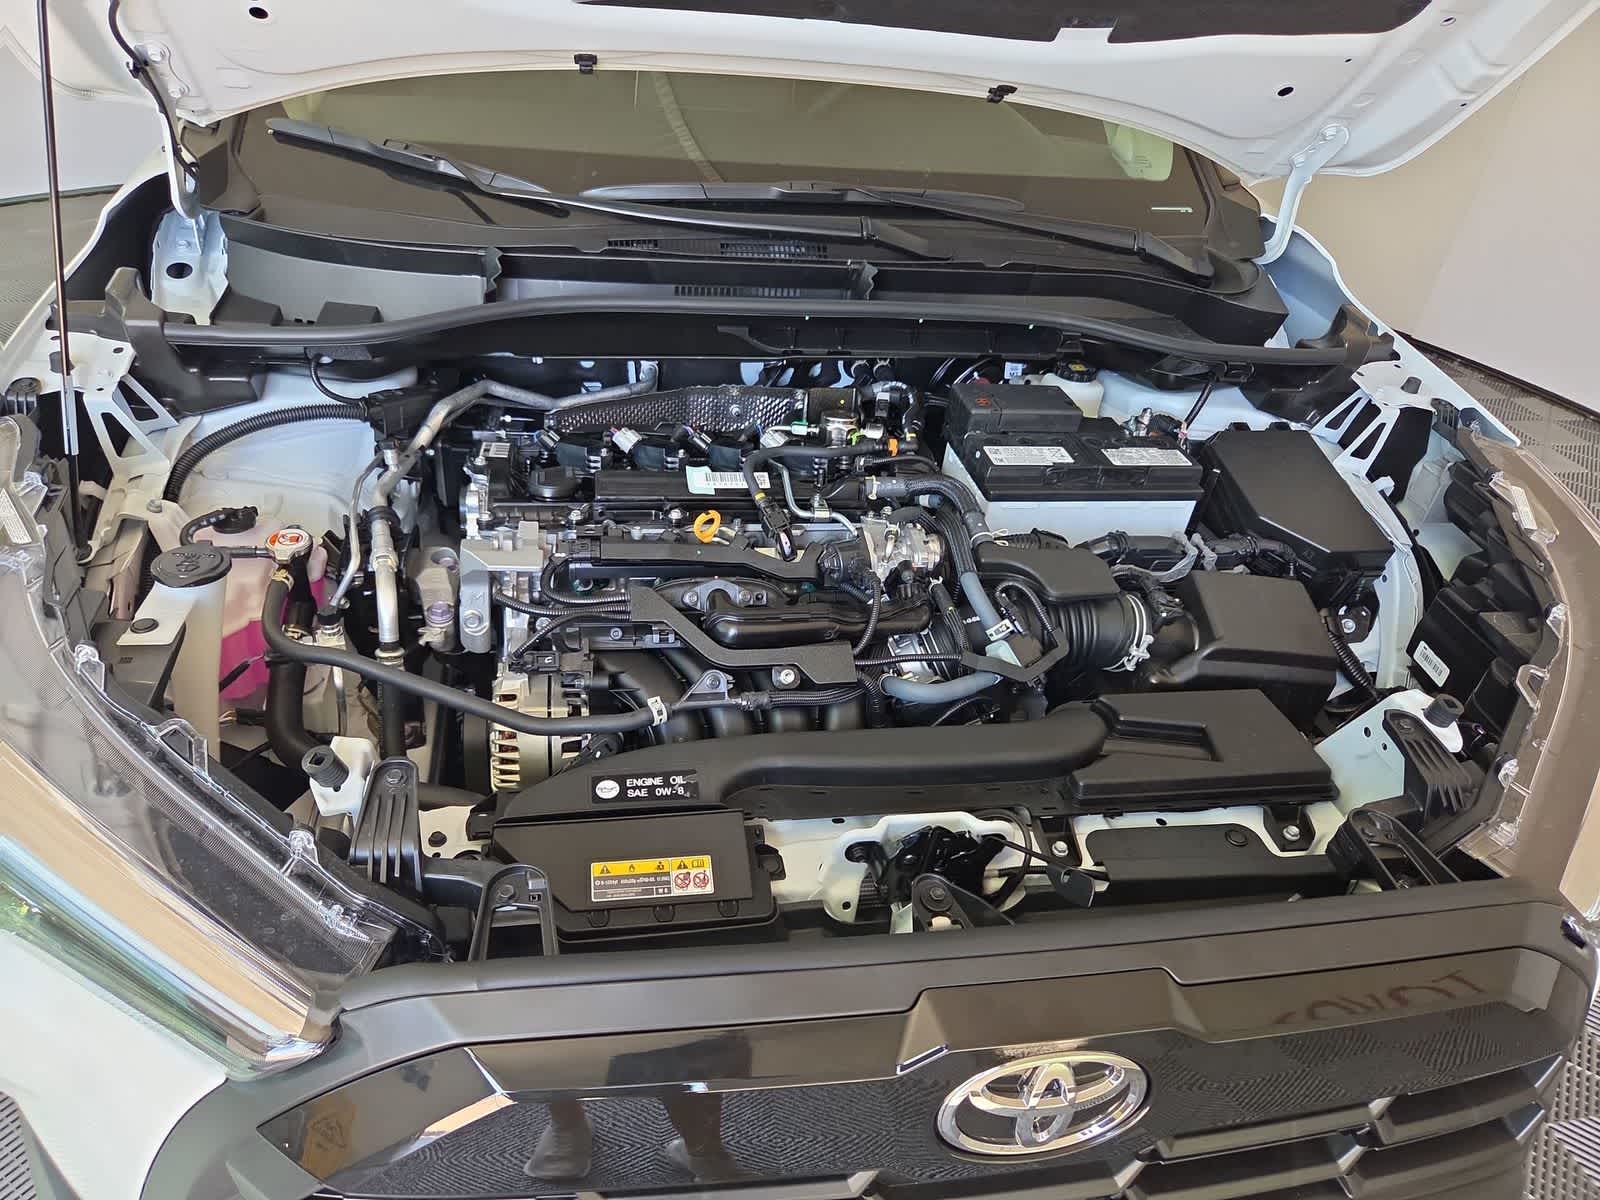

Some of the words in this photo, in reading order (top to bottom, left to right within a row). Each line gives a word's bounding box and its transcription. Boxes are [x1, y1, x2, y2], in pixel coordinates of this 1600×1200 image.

[626, 777, 664, 787] ENGINE
[670, 776, 687, 785] OIL
[627, 788, 648, 798] SAE
